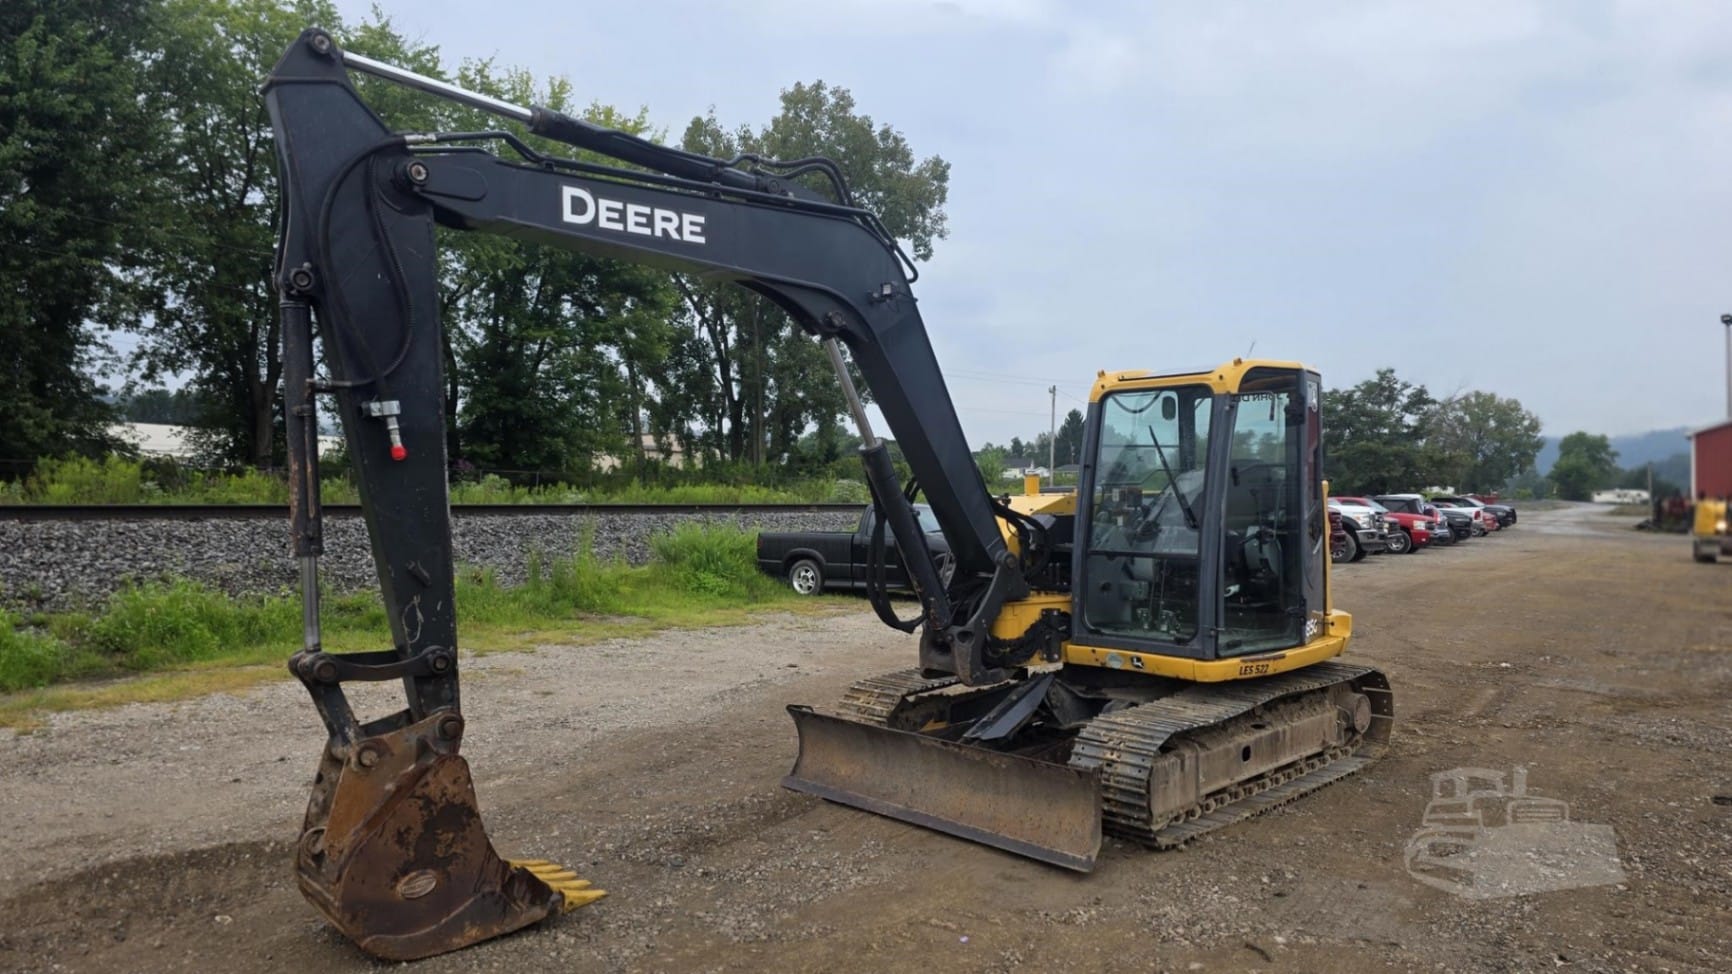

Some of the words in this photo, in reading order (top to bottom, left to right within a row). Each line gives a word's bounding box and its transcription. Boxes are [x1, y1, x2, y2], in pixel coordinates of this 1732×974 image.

[562, 185, 706, 244] DEERE
[1239, 665, 1254, 675] LES
[1254, 663, 1270, 674] 522
